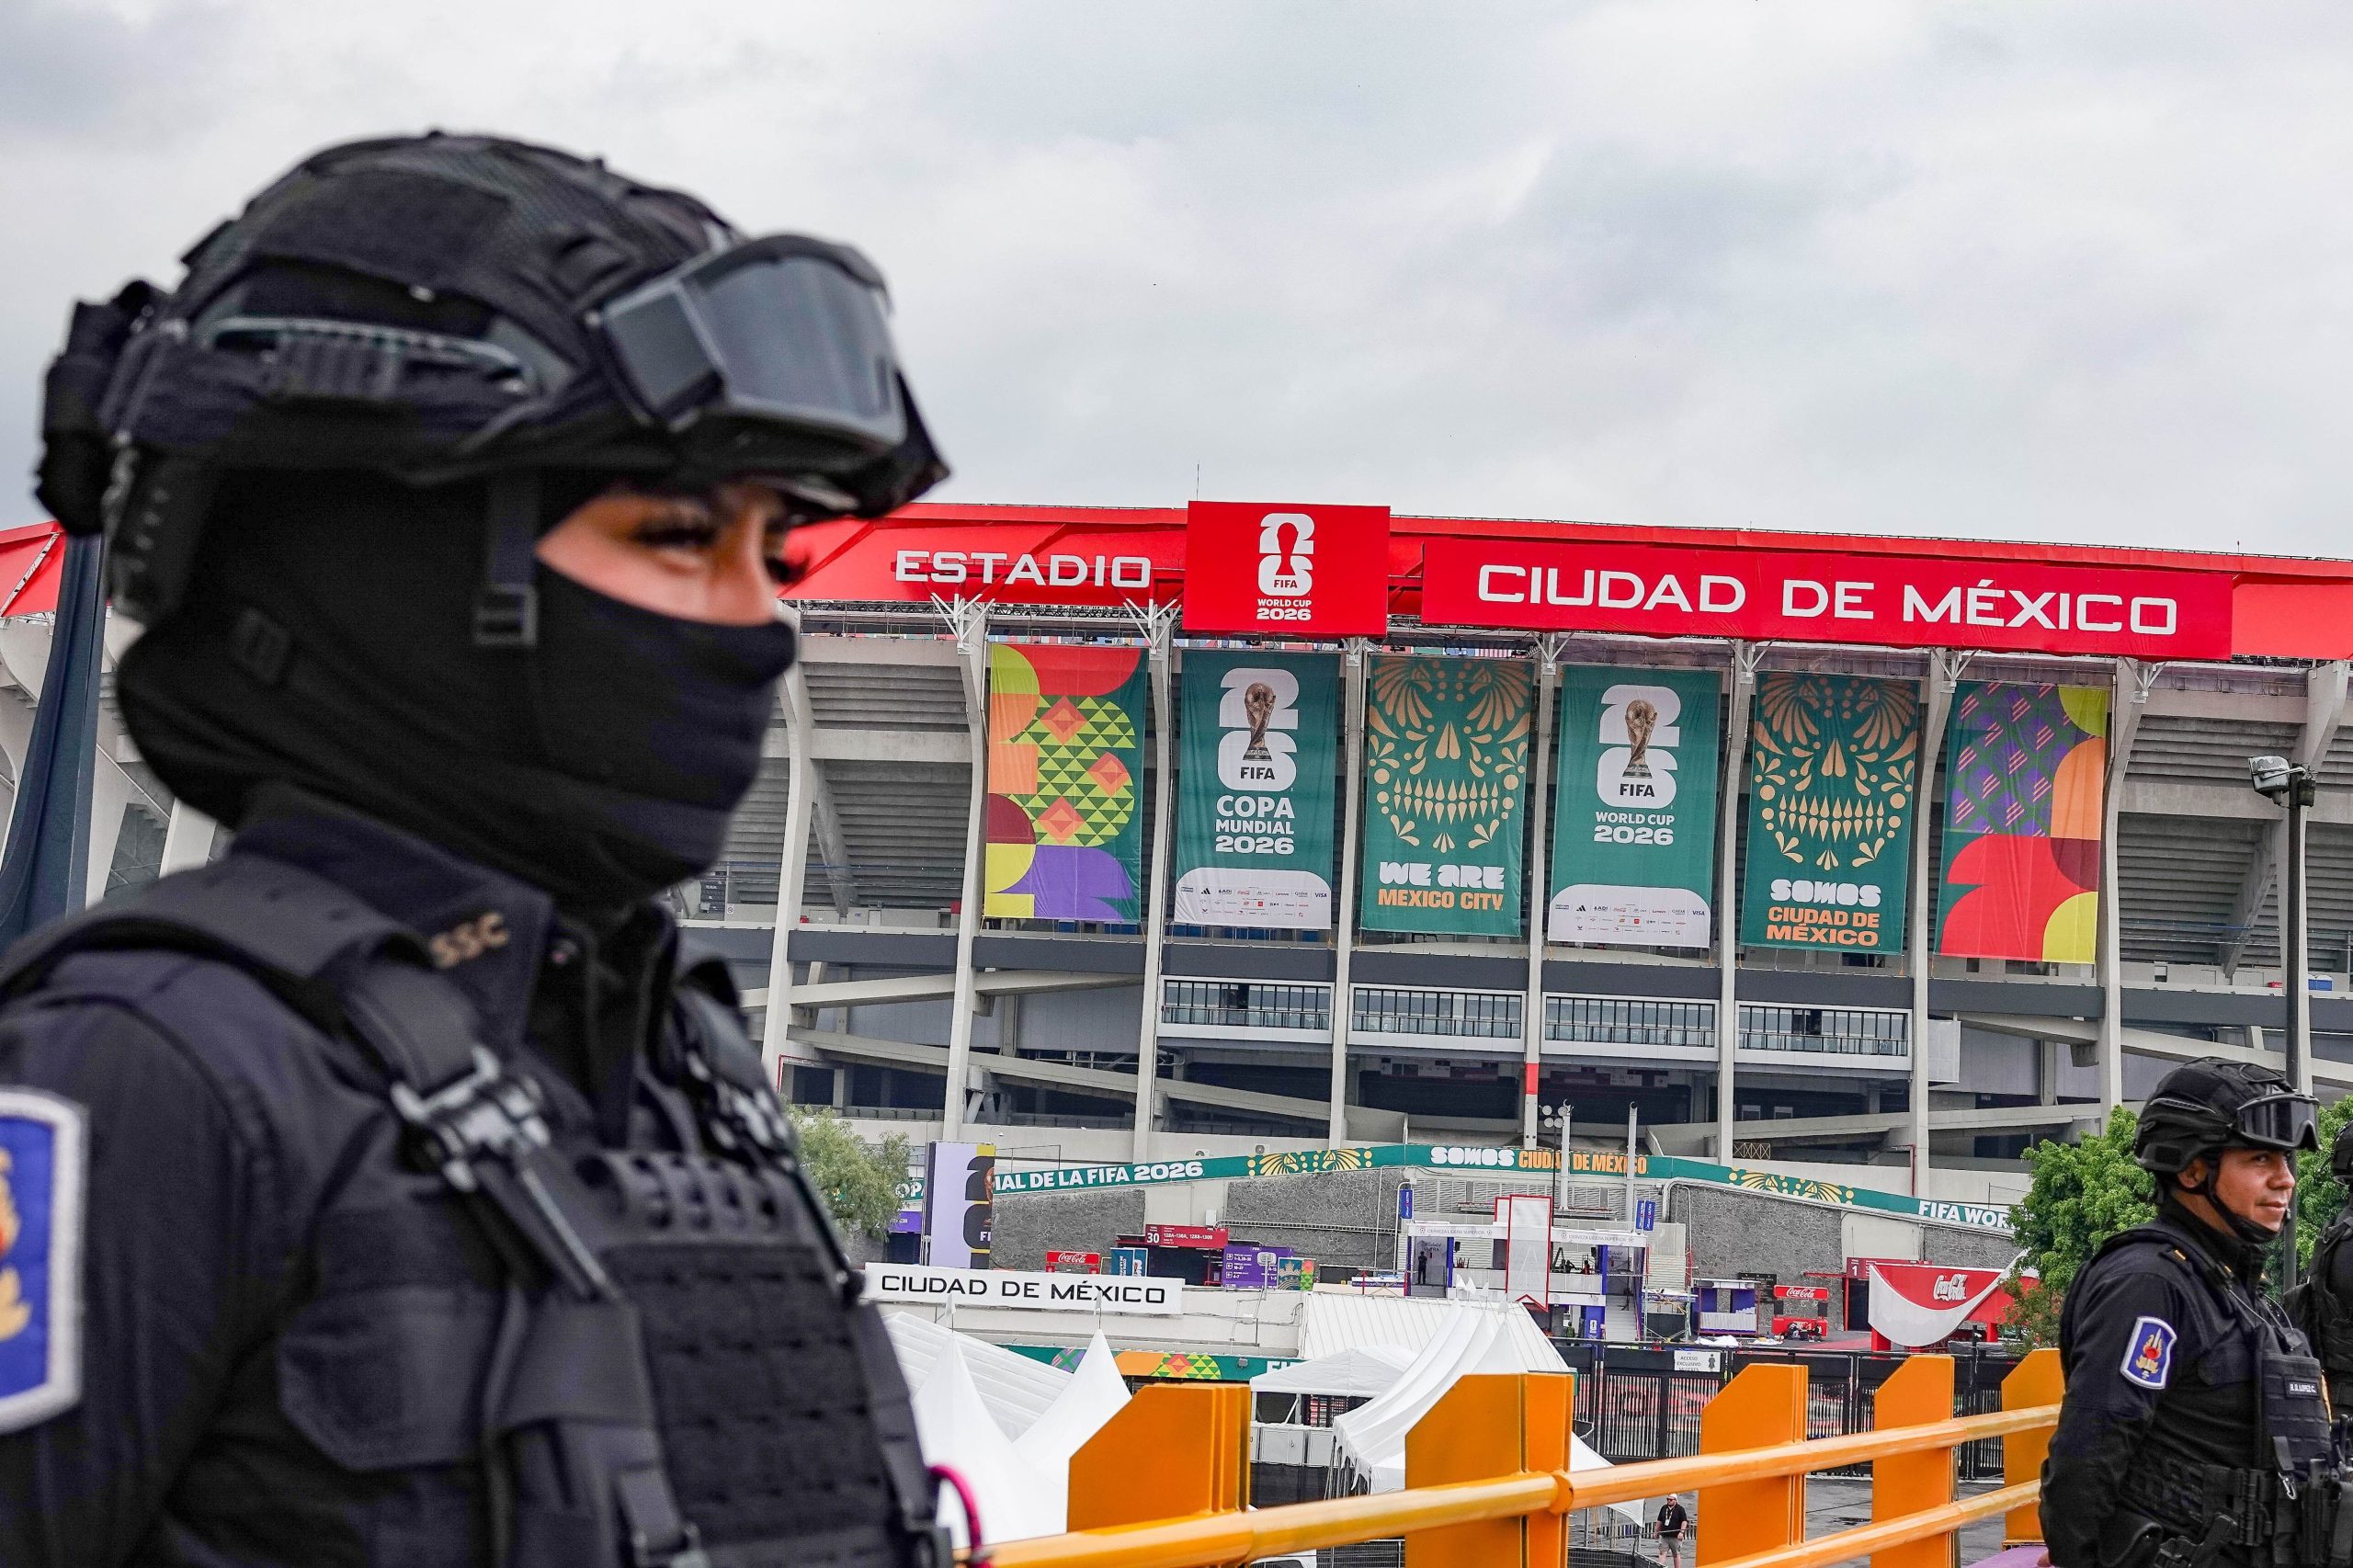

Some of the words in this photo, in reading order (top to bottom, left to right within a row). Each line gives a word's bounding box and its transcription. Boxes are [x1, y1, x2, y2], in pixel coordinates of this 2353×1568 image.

[895, 550, 1151, 588] ESTADIO
[1273, 579, 1298, 588] FIFA
[1257, 598, 1291, 607] WORLD
[1292, 599, 1312, 608] CUP
[1477, 563, 1746, 614] CIUDAD
[1781, 579, 1875, 620] DE
[1902, 578, 2177, 636] MÉXICO
[1256, 608, 1312, 620] 2026
[1240, 767, 1276, 779] FIFA
[1620, 783, 1655, 797] FIFA
[1216, 795, 1295, 819] COPA
[1215, 819, 1295, 835] MUNDIAL
[1595, 812, 1645, 824] WORLD
[1647, 814, 1675, 825] CUP
[1215, 835, 1295, 855] 2026
[1594, 825, 1674, 846] 2026
[1379, 861, 1432, 887] WE
[1438, 864, 1506, 890] ARE
[1378, 888, 1455, 909] MEXICO
[1460, 892, 1504, 911] CITY
[1770, 879, 1881, 907] SOMOS
[1768, 906, 1848, 926] CIUDAD
[1852, 912, 1881, 928] DE
[428, 913, 510, 969] SSC
[1767, 923, 1879, 947] MÉXICO
[1430, 1146, 1515, 1167] SOMOS
[1518, 1150, 1570, 1170] CIUDA
[1573, 1153, 1590, 1171] DE
[1029, 1172, 1055, 1188] DE
[1058, 1169, 1085, 1187] LA
[1087, 1166, 1131, 1185] FIFA
[1133, 1161, 1203, 1181] 2026
[1918, 1200, 1961, 1221] FIFA
[1964, 1207, 2014, 1229] WOR
[980, 1232, 991, 1242] FI
[1146, 1233, 1160, 1244] 30
[1852, 1266, 1858, 1277] 1
[881, 1275, 987, 1295] CIUDAD
[1001, 1280, 1040, 1299] DE
[1051, 1280, 1165, 1303] MÉXICO
[1786, 1287, 1816, 1299] Coca-Cola
